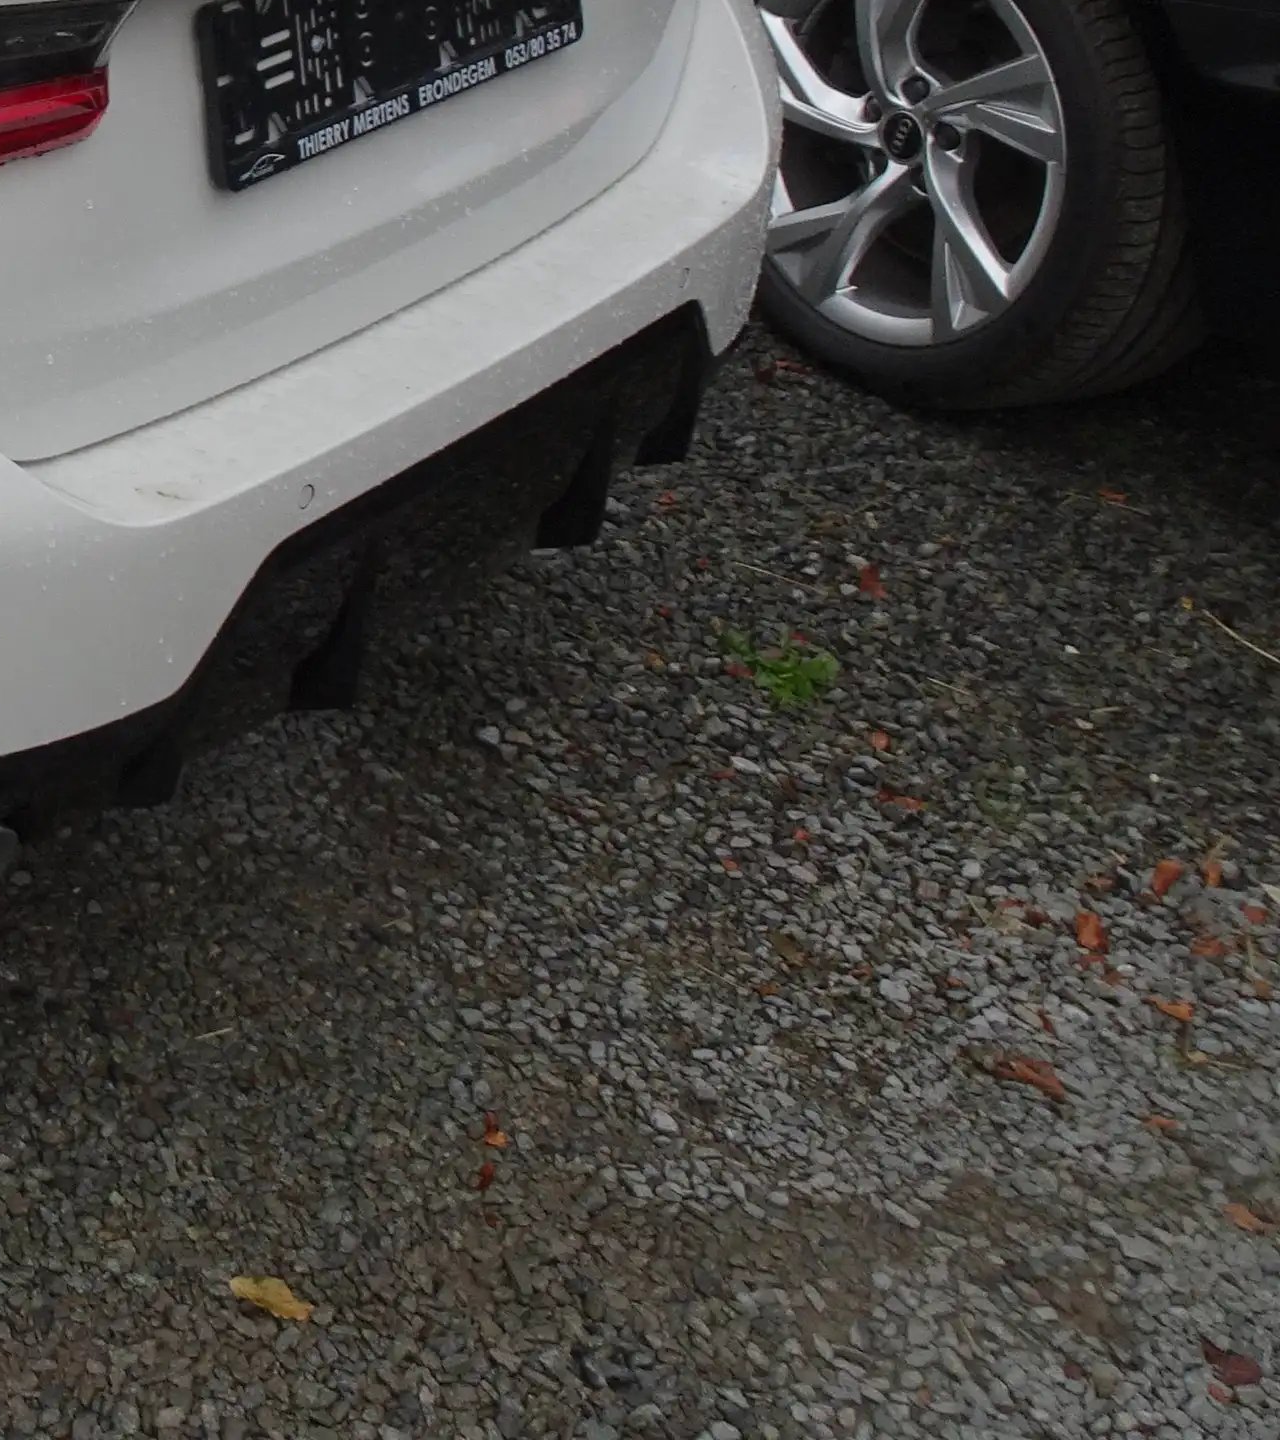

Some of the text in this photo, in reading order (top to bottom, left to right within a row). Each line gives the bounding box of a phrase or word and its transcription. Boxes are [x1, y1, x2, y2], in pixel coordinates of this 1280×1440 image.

[297, 21, 577, 160] THIERRY MERTENS ERONDEGEM 053/80 35 74
